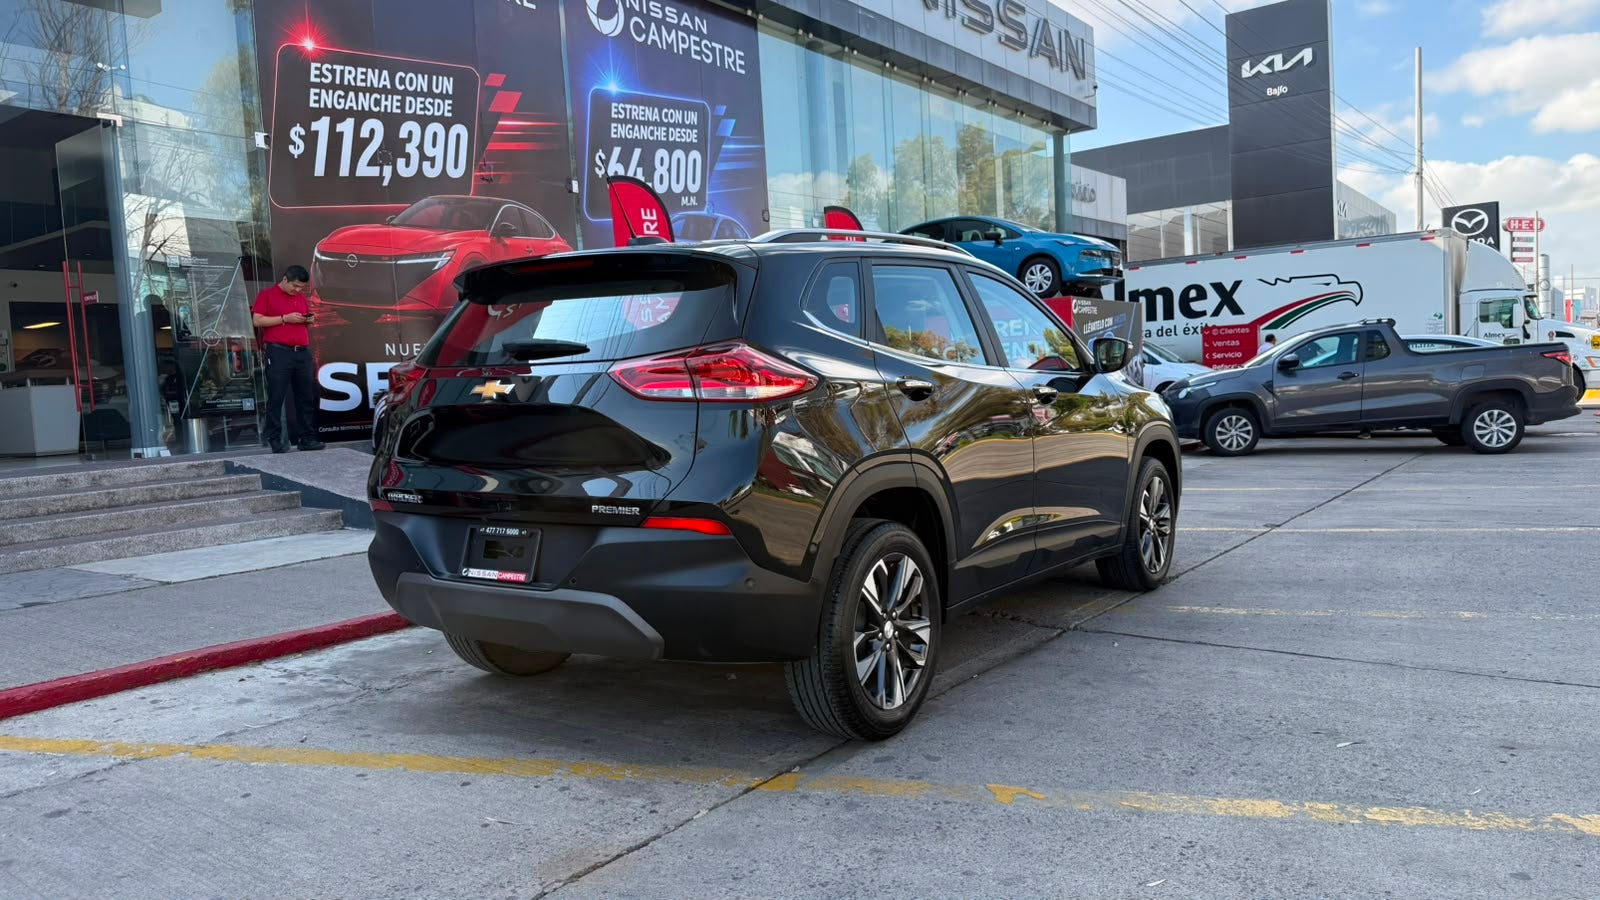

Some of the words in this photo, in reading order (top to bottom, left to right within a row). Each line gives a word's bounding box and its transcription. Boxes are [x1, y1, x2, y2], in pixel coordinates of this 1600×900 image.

[625, 0, 708, 35] NISSAN
[630, 17, 746, 74] CAMPESTRE
[924, 0, 1086, 80] SSAN
[1241, 47, 1313, 79] KIA
[310, 62, 391, 89] ESTRENA
[395, 71, 428, 93] CON
[432, 76, 453, 95] UN
[1266, 85, 1288, 97] Bajío
[309, 88, 401, 113] ENGANCHE
[405, 97, 453, 117] DESDE
[611, 102, 660, 122] ESTRENA
[661, 108, 683, 124] CON
[684, 111, 698, 125] UN
[610, 123, 667, 141] ENGANCHE
[668, 127, 698, 143] DESDE
[681, 196, 698, 206] M.N.
[640, 207, 660, 235] RE
[1144, 329, 1152, 338] a
[1156, 326, 1178, 338] del
[1219, 327, 1250, 335] Clientes
[385, 343, 422, 356] NUE
[1212, 339, 1240, 348] Ventas
[1212, 351, 1242, 360] Servicio
[318, 361, 402, 412] SE
[591, 505, 640, 515] PREMIER
[468, 569, 498, 578] NISSAN
